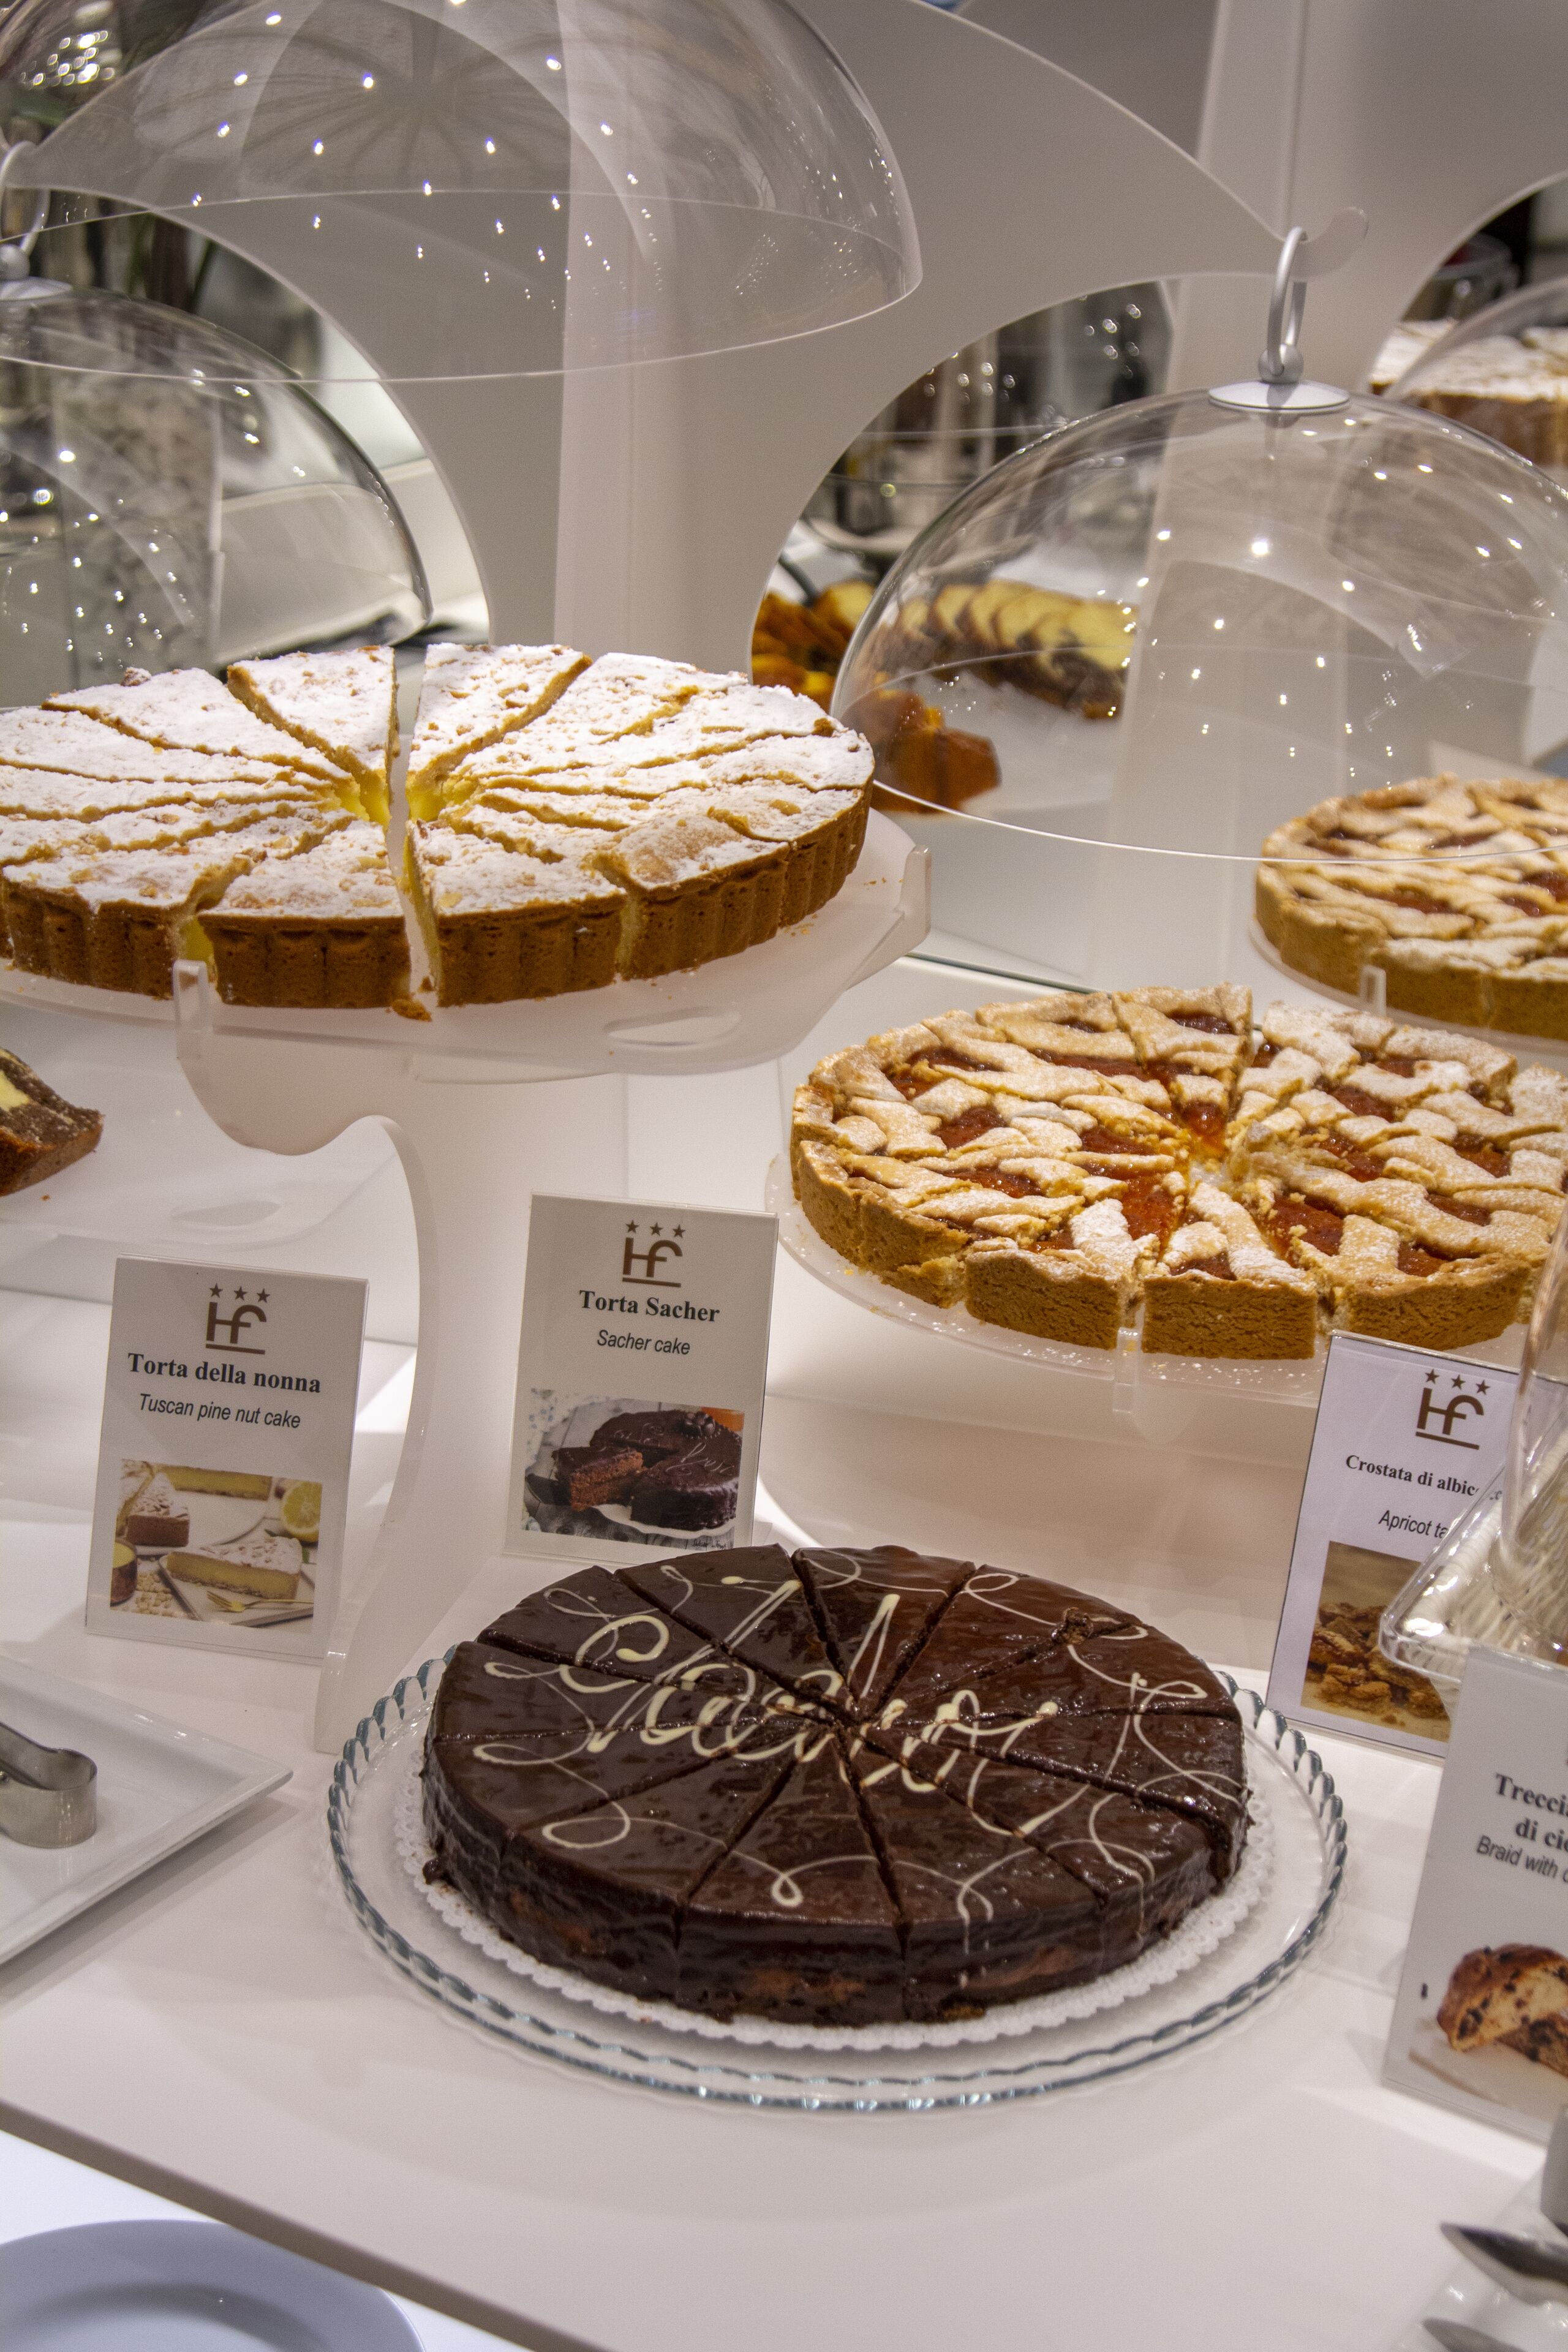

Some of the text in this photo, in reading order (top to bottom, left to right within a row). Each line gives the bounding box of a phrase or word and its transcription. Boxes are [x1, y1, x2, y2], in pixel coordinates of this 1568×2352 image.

[579, 1289, 720, 1322] Torta Sacher
[597, 1329, 690, 1355] Sacher cake
[127, 1352, 321, 1393] Torta della nonna
[140, 1393, 301, 1428] Tuscan pine nut cake
[1346, 1455, 1480, 1496] Crostata di albic
[1378, 1509, 1449, 1539] Apricot ta
[1515, 1817, 1539, 1842] di
[1477, 1834, 1523, 1866] Braid
[1525, 1855, 1559, 1879] with
